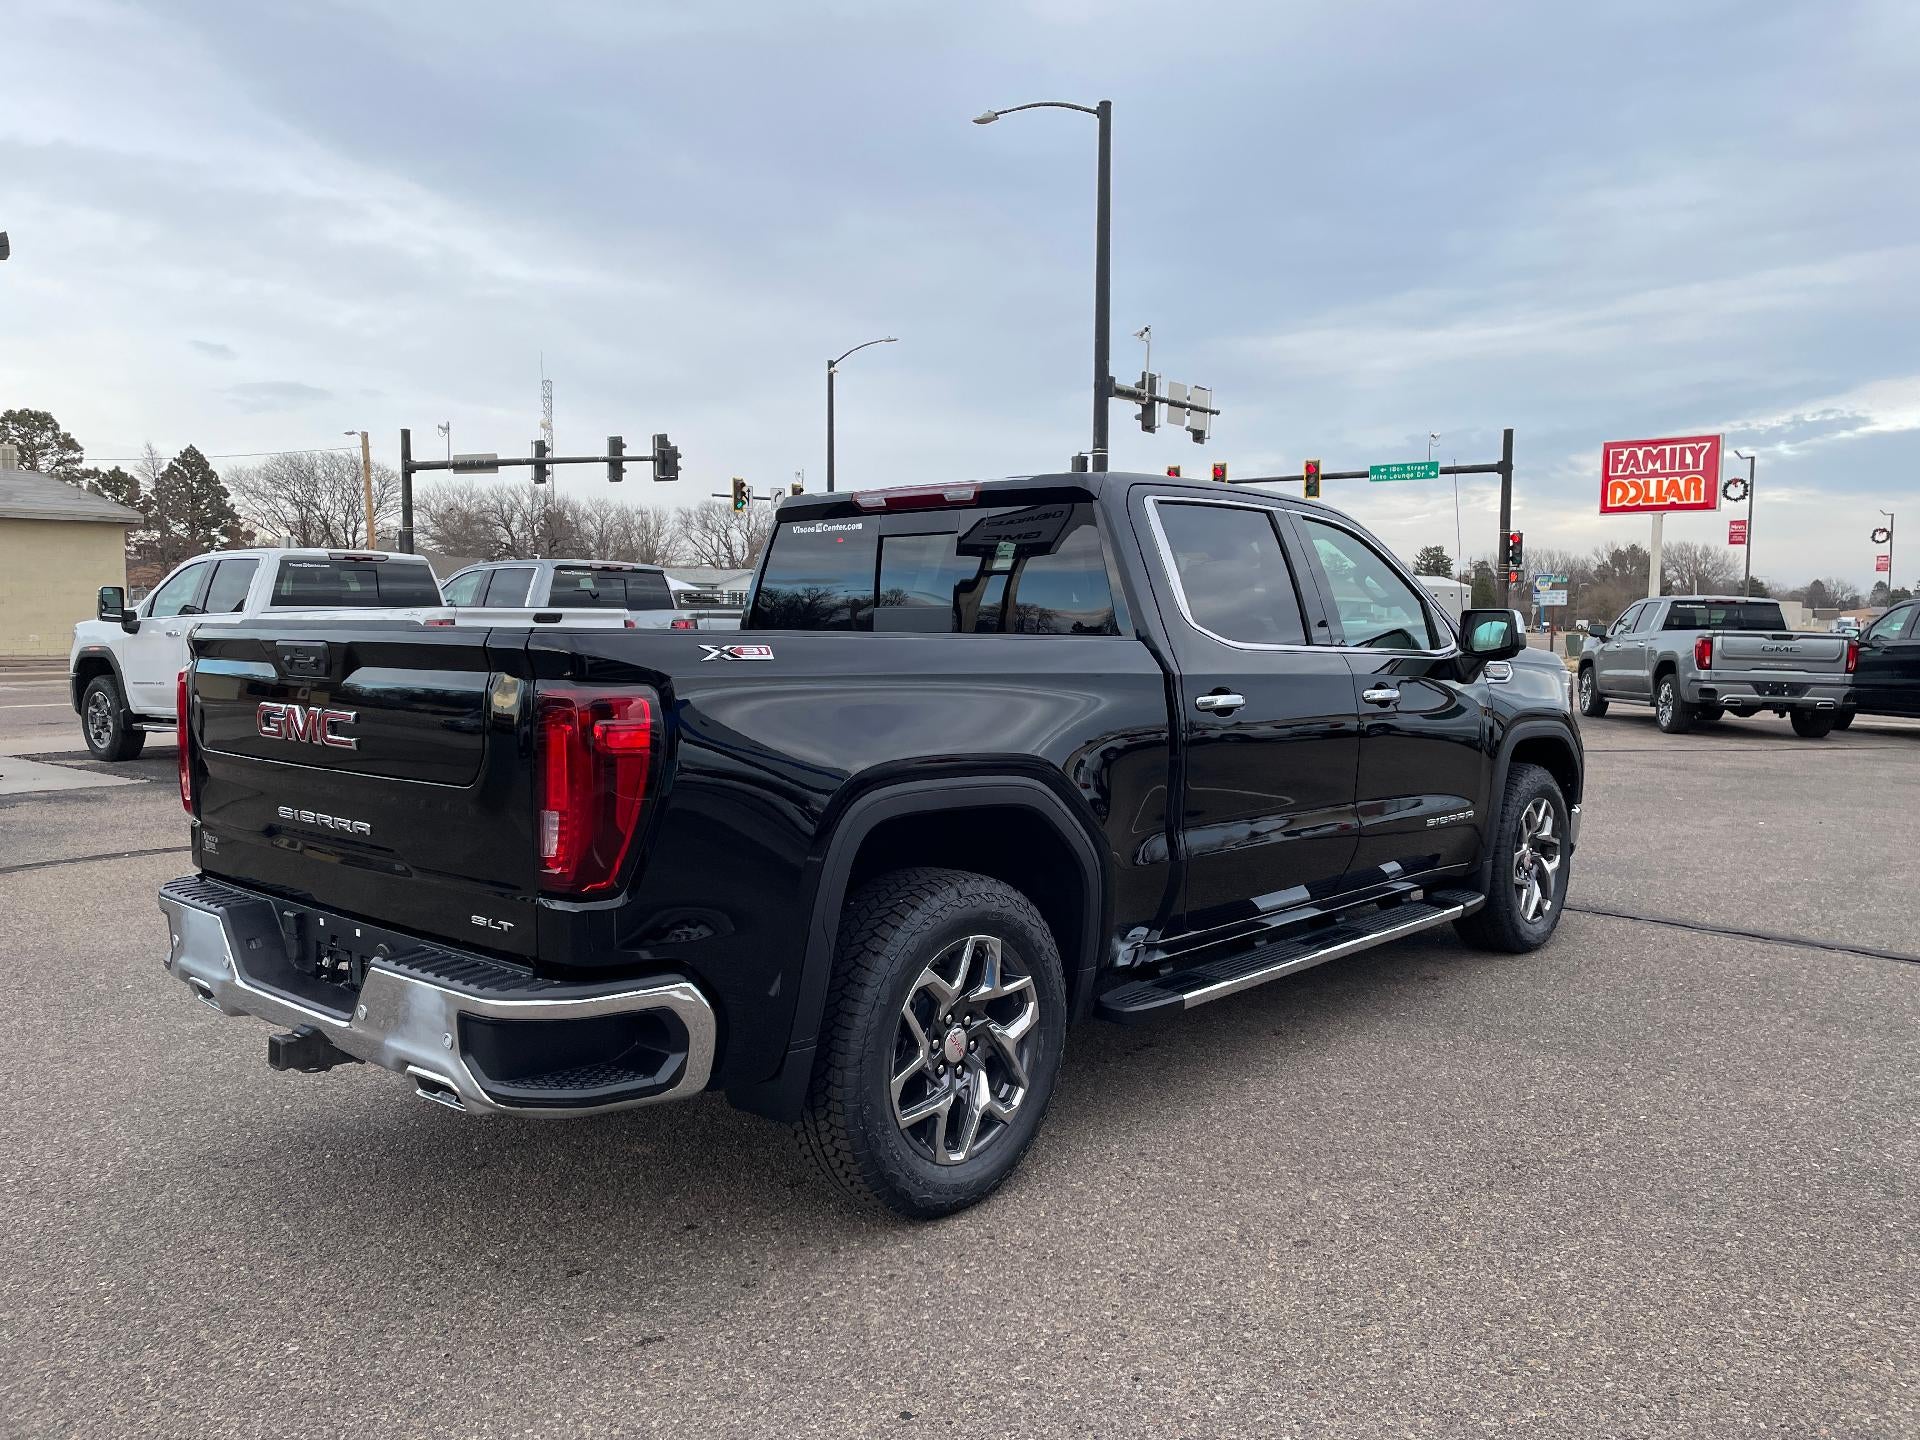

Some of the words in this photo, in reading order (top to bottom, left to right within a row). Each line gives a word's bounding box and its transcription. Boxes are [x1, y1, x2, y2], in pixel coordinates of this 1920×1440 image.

[1609, 442, 1711, 476] FAMILY
[1607, 475, 1705, 507] DOLLAR
[1761, 644, 1803, 653] GMC
[256, 701, 361, 750] GMC
[277, 805, 372, 836] SIERRA
[1426, 810, 1475, 827] SIERRA
[470, 915, 515, 932] SLT
